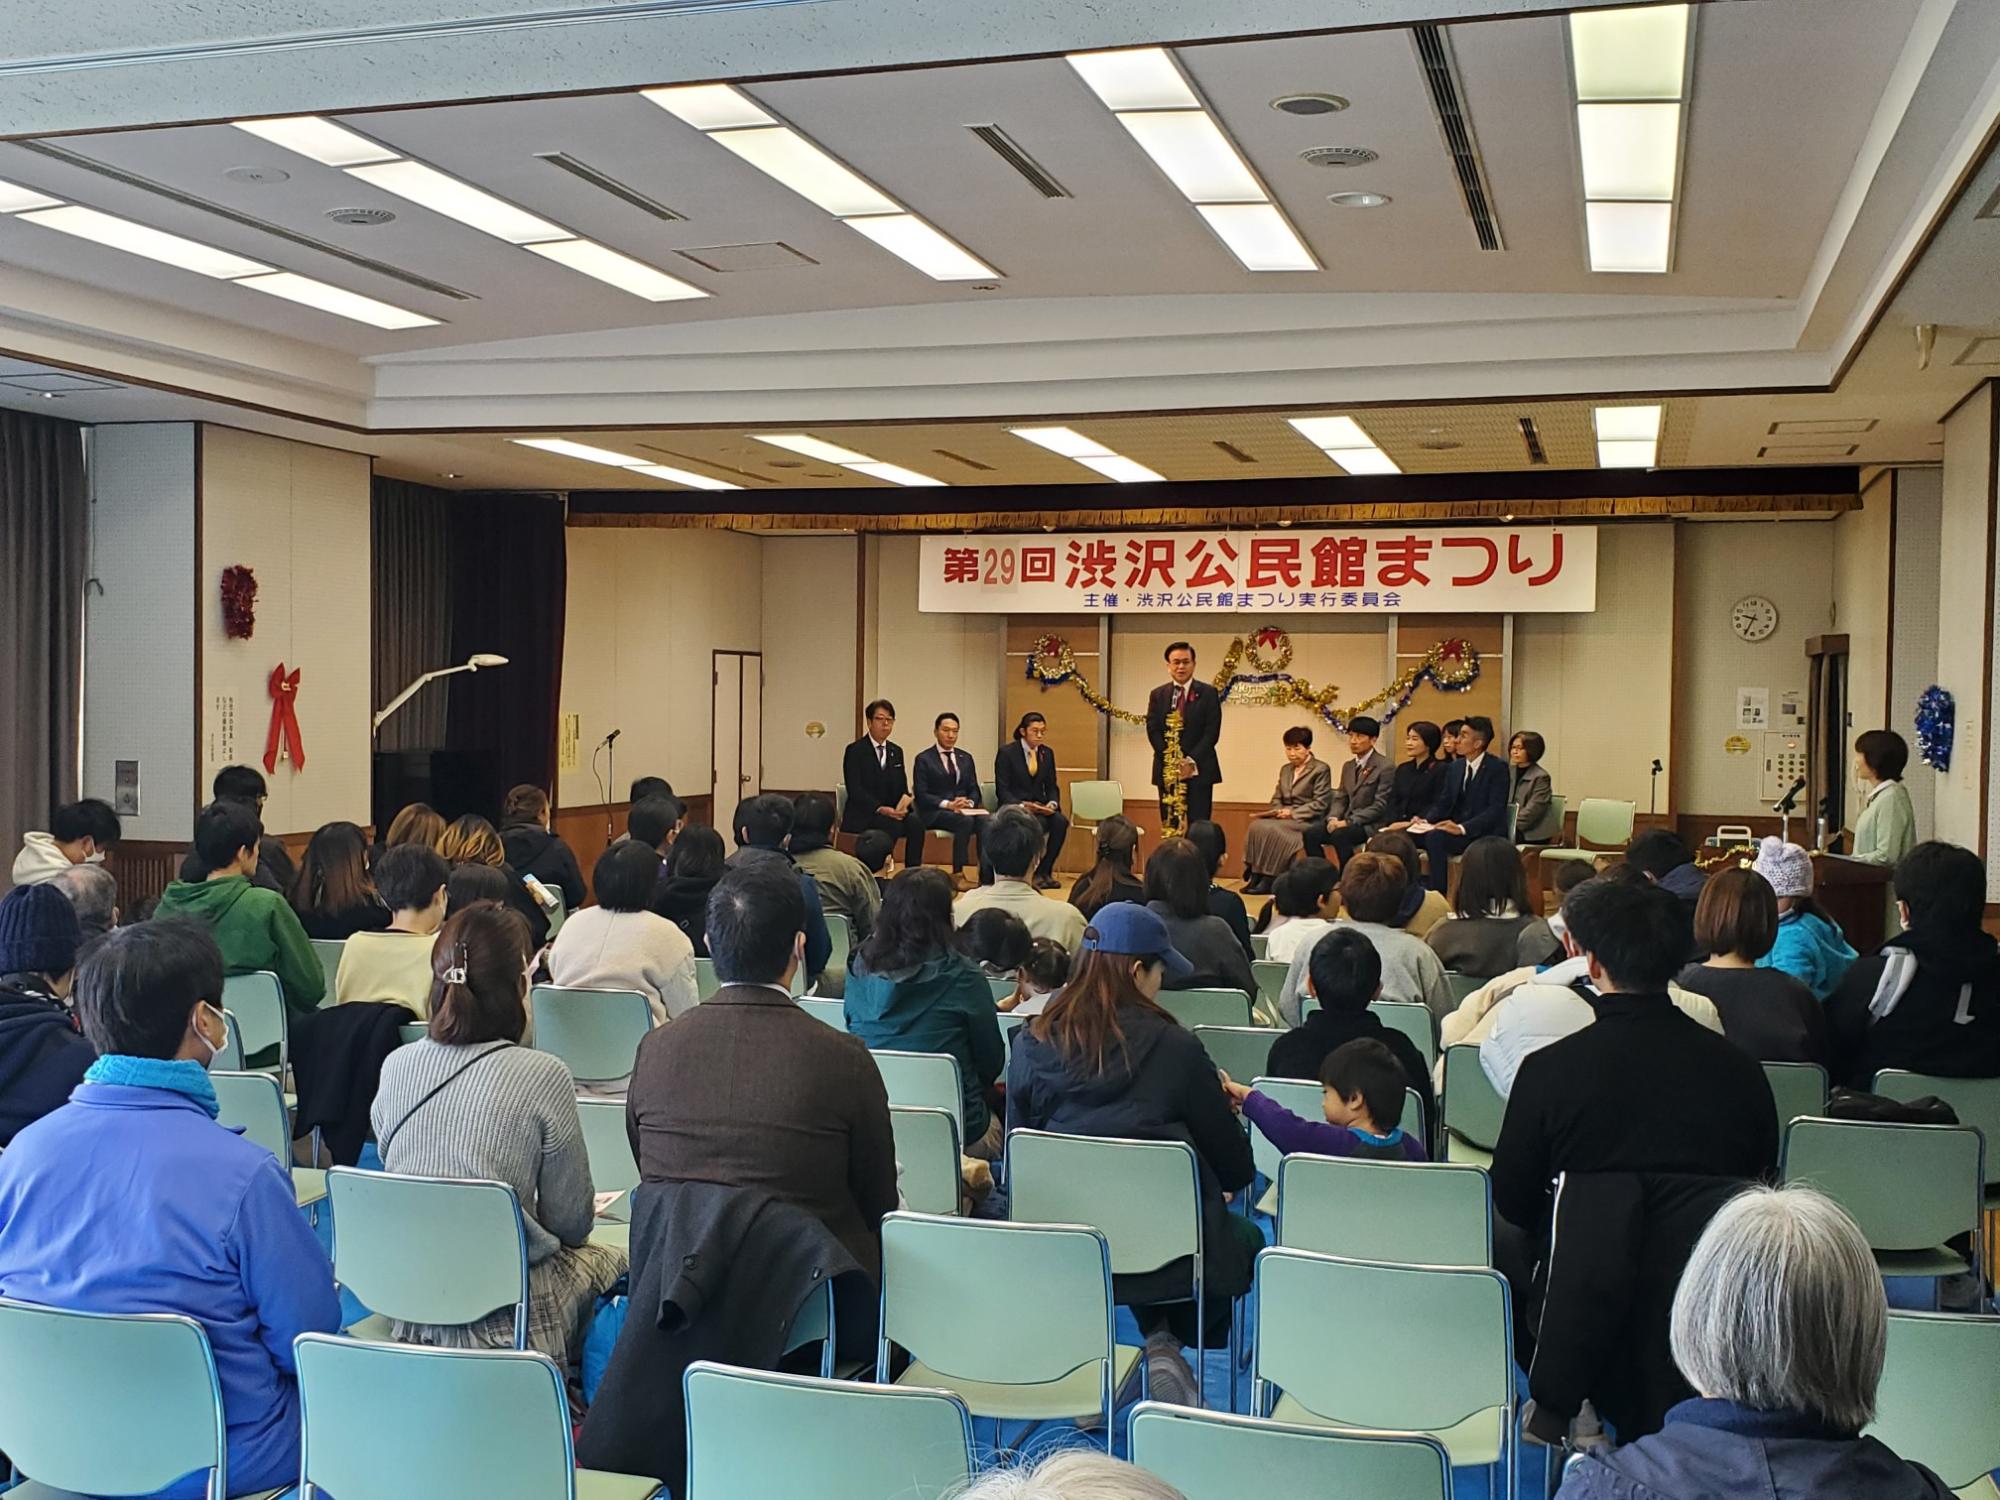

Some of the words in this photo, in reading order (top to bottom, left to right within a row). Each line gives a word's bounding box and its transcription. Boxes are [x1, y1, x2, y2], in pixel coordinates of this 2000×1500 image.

[943, 533, 1564, 589] 第29回渋沢公民館まつり
[1084, 592, 1402, 608] 主催・渋沢公民館まつり実行委員会
